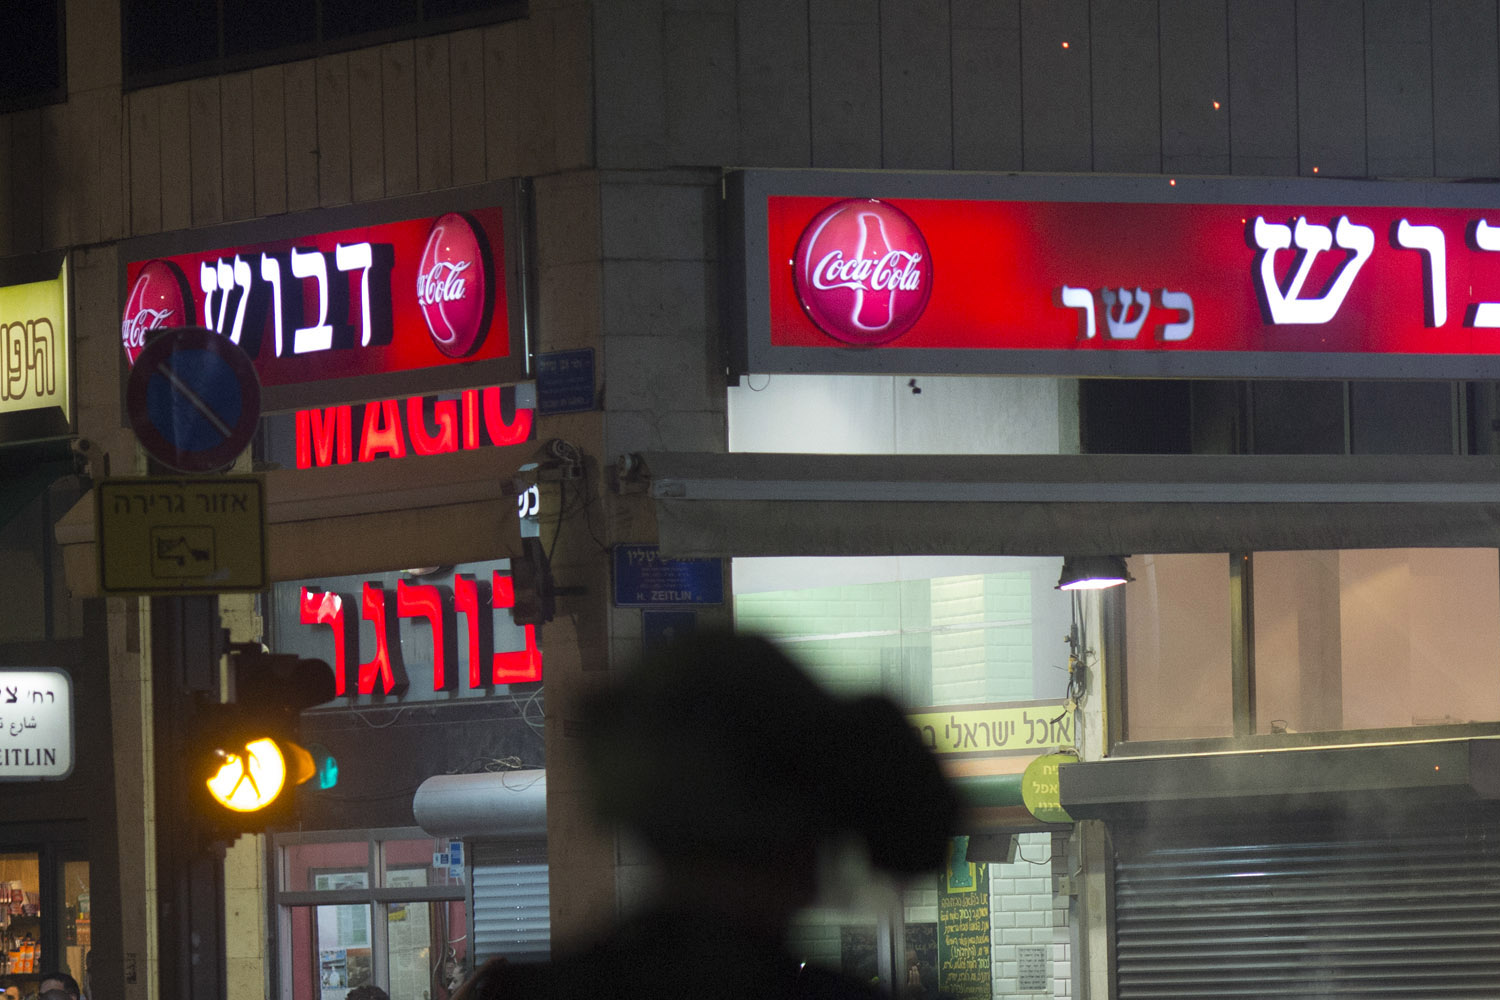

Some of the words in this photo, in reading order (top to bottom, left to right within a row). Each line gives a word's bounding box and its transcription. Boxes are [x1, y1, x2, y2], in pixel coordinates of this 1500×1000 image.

[812, 250, 922, 292] Coca-Cola
[201, 242, 372, 358] דבוש
[1061, 284, 1195, 341] כשר
[295, 387, 534, 469] MAGIC
[114, 493, 186, 514] גרירה
[197, 492, 248, 513] אזור
[651, 590, 692, 601] ZEITLIN
[300, 569, 543, 697] בורגר
[945, 715, 1015, 749] ישראלי
[1023, 711, 1072, 745] אוכל
[1032, 780, 1059, 794] אפל
